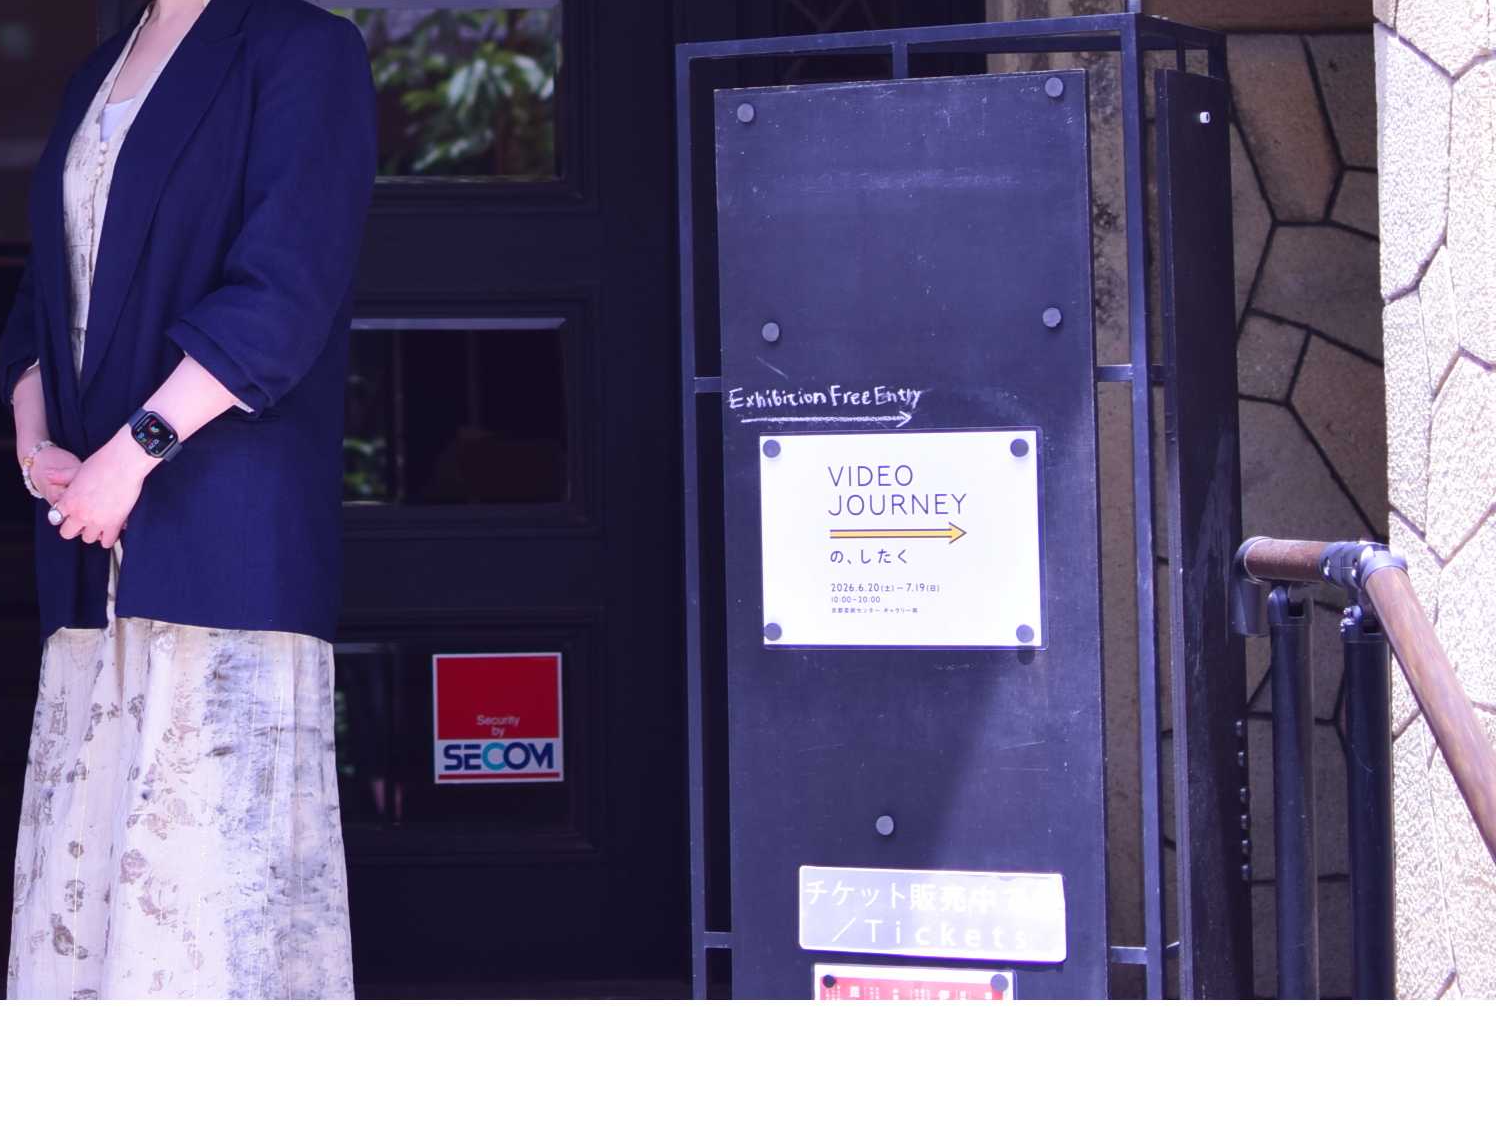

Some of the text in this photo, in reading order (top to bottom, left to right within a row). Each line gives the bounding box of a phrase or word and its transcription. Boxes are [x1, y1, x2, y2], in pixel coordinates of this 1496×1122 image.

[729, 385, 922, 410] Exhibition Free Entry
[828, 464, 914, 487] VIDEO
[828, 493, 967, 516] JOURNEY
[830, 549, 907, 564] の、したく
[476, 714, 521, 727] Security
[491, 726, 505, 738] by
[443, 742, 554, 771] SECOM
